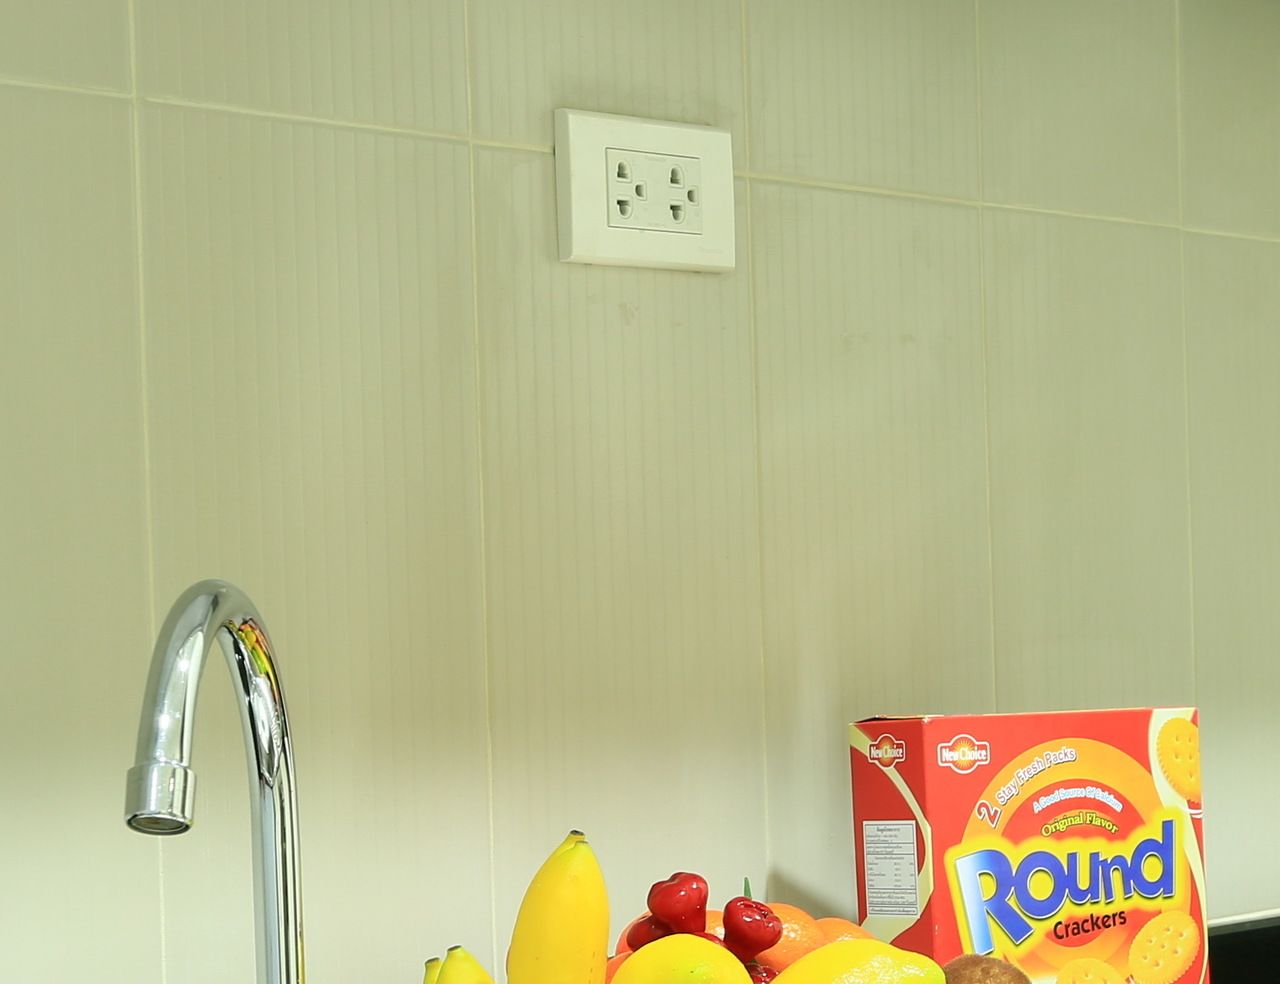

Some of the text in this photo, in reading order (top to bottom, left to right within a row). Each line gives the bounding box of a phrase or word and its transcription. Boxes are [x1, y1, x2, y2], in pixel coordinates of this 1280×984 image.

[941, 746, 987, 762] New Choice
[976, 746, 1077, 829] 2 Stay Fresh Packs
[1041, 811, 1119, 837] Original Flavor
[955, 819, 1176, 956] Round
[1053, 910, 1128, 940] Crackers
